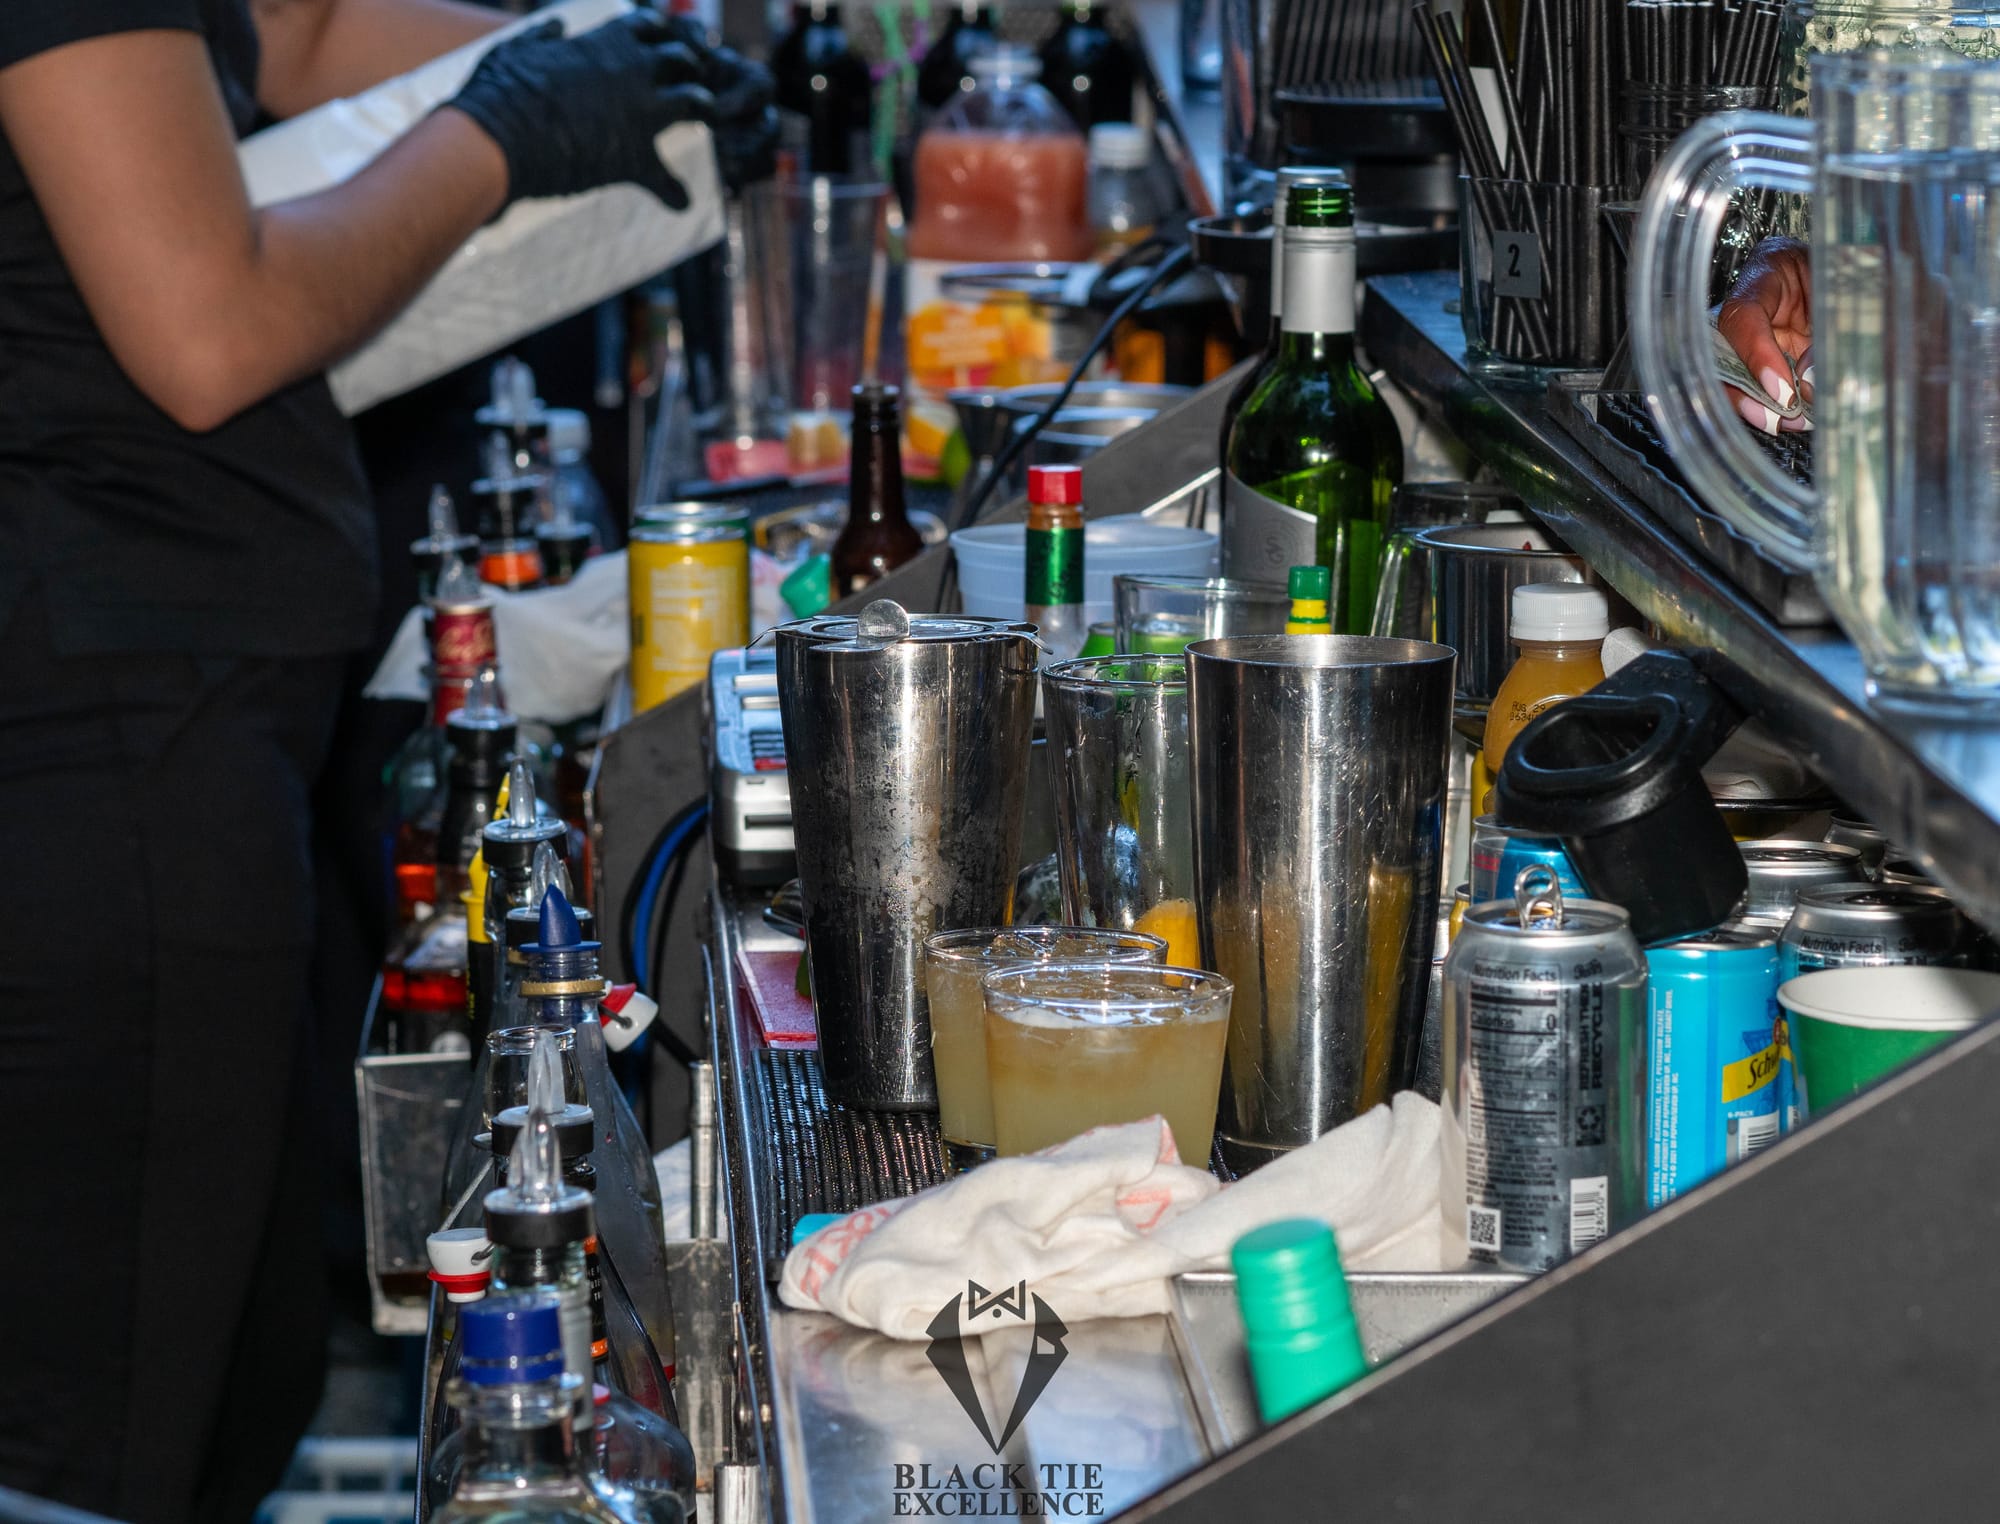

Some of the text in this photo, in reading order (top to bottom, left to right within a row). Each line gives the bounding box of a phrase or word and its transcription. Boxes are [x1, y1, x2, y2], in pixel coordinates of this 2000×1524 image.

[1508, 243, 1520, 277] 2
[1532, 703, 1546, 713] 29
[1801, 935, 1846, 952] Nutrition
[1848, 939, 1882, 953] Facts
[1473, 963, 1520, 981] Nutrition
[1523, 967, 1557, 981] Facts
[1546, 1013, 1557, 1031] 0
[1591, 982, 1603, 1090] RECYCLE
